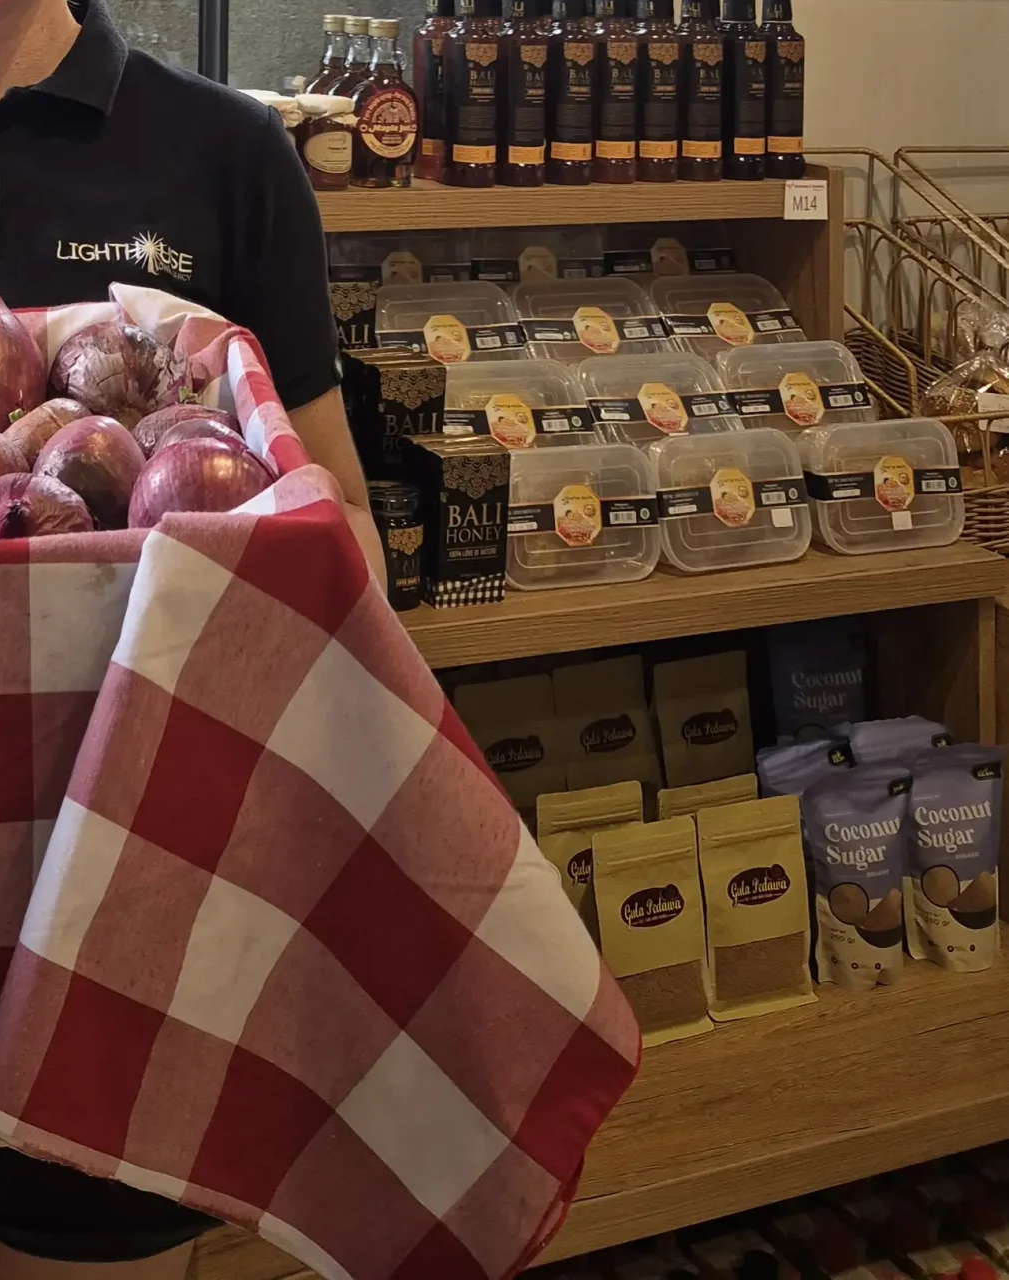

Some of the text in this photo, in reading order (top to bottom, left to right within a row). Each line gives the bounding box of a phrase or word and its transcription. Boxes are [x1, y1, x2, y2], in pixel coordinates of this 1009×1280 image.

[792, 195, 818, 212] M14
[57, 240, 193, 273] LIGHTHUSE
[338, 324, 370, 345] ALI
[384, 412, 438, 436] BALI
[448, 502, 502, 528] BALI
[446, 525, 503, 544] HONEY
[791, 668, 863, 689] Coconut
[793, 692, 847, 714] Sugar
[914, 799, 992, 827] Coconut
[917, 827, 975, 853] Sugar
[826, 843, 887, 871] Sugar
[730, 882, 751, 904] Gula
[752, 877, 787, 894] Pedawa
[624, 901, 645, 926] Gula
[646, 898, 682, 915] Pedawa
